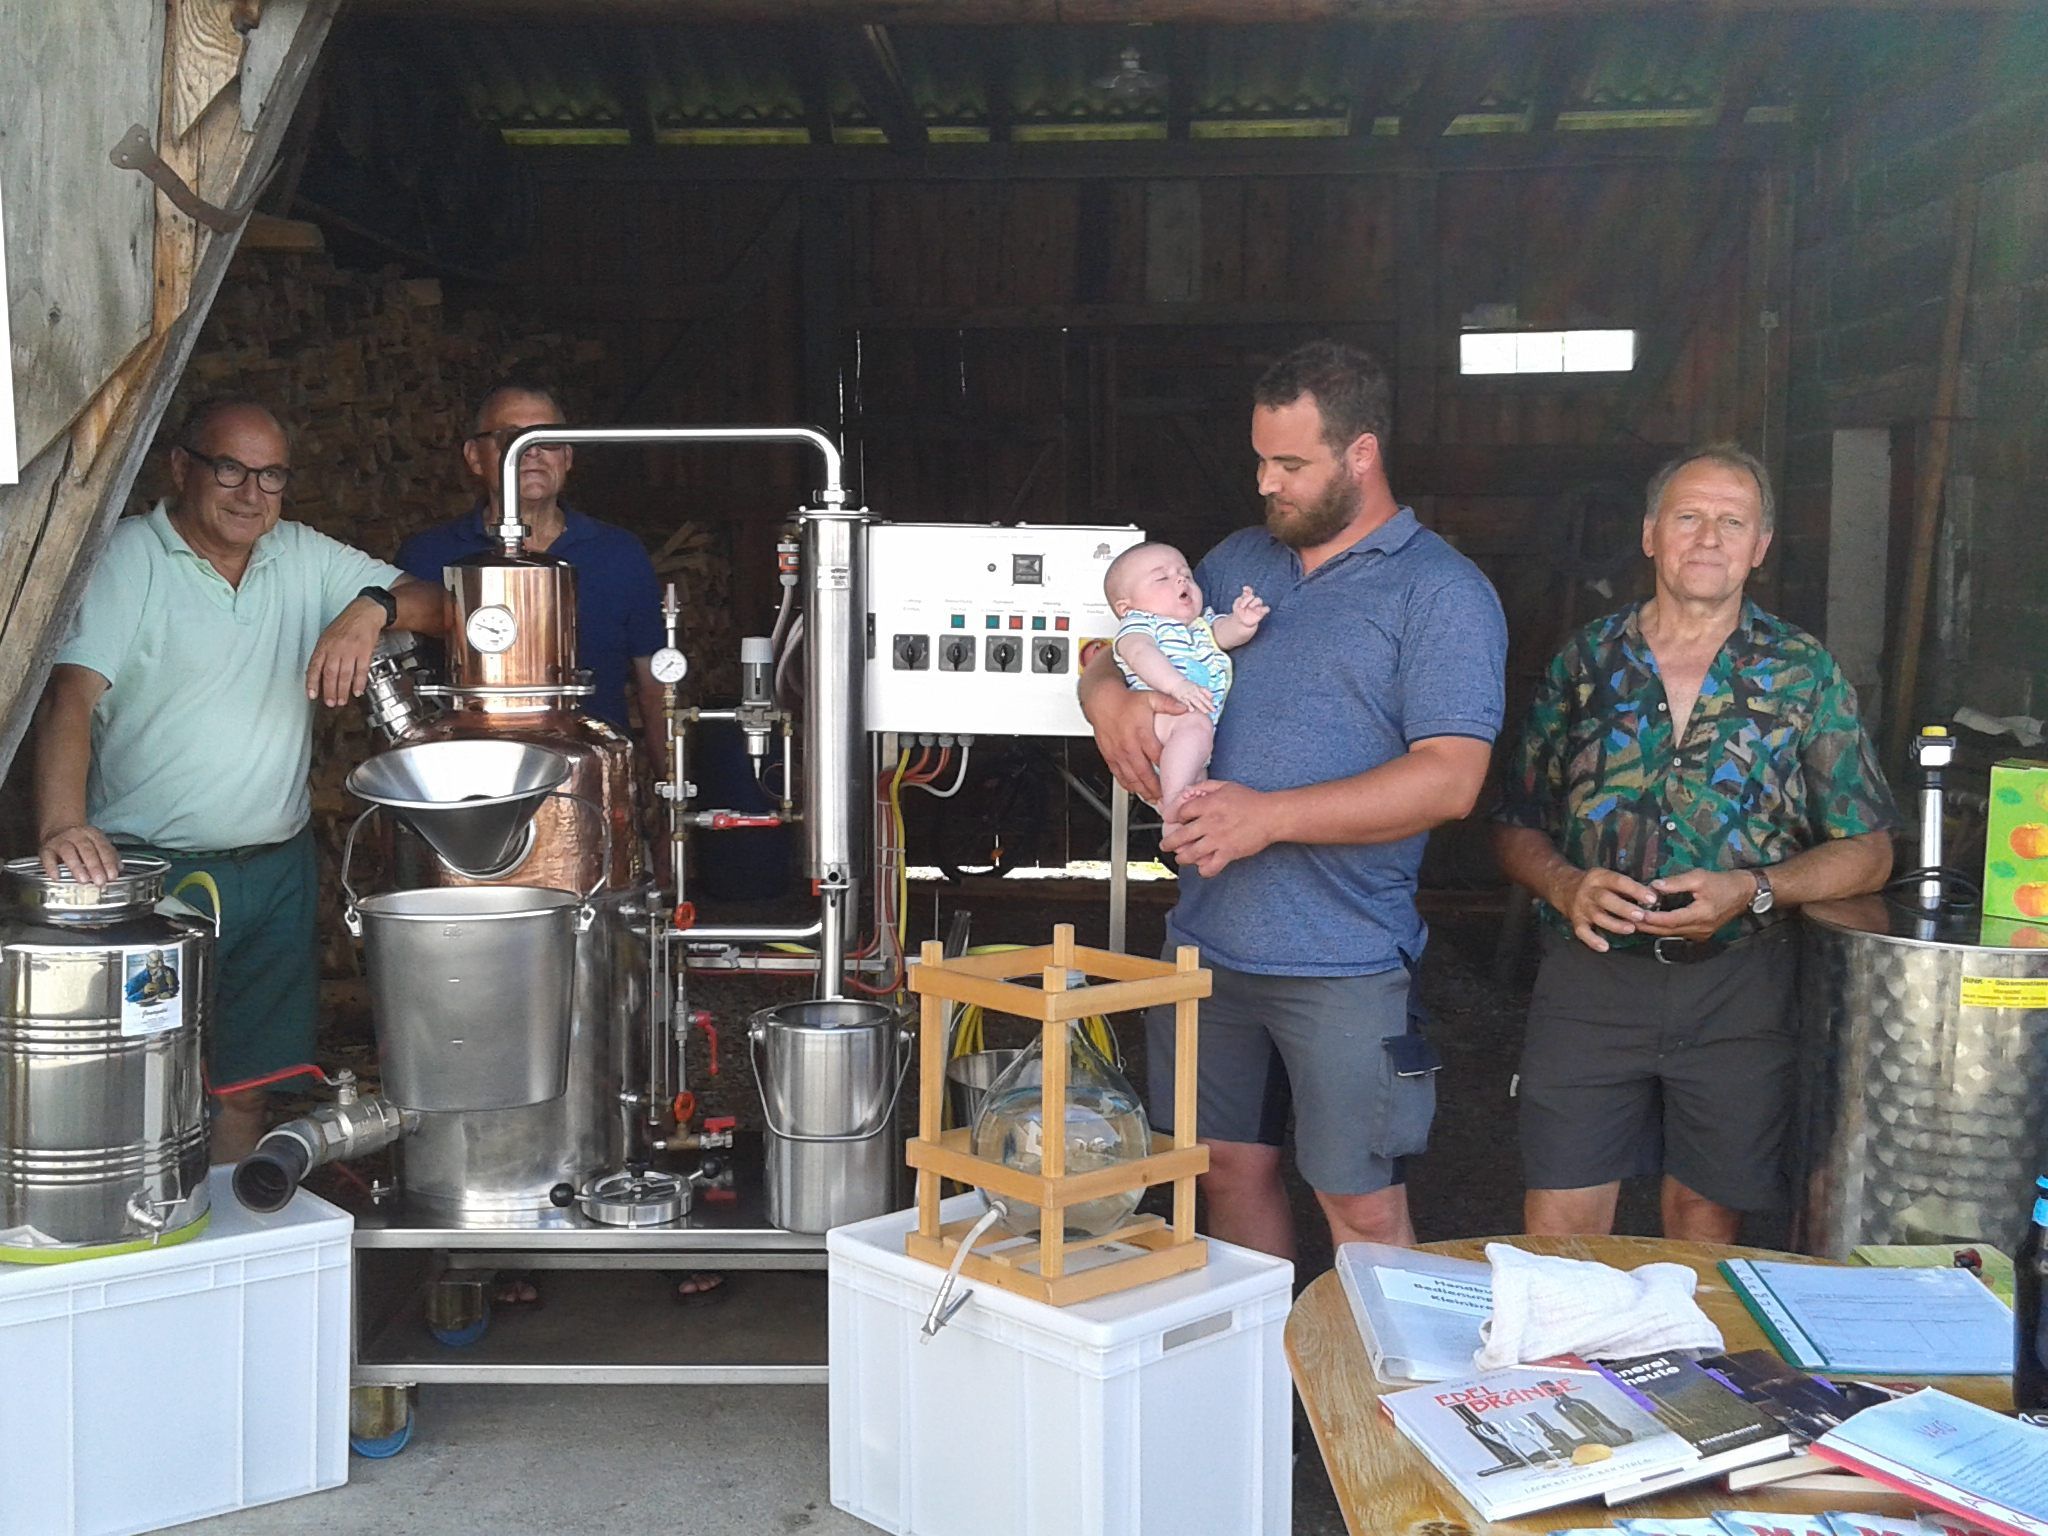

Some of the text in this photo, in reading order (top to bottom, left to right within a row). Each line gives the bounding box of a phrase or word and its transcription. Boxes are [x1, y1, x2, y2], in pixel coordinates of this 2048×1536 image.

[1413, 1283, 1493, 1302] Bedienung
[1434, 1280, 1493, 1294] Handbu
[1430, 1295, 1494, 1310] Kleinbre
[1621, 1366, 1680, 1386] heute
[1434, 1385, 1499, 1407] EDEL
